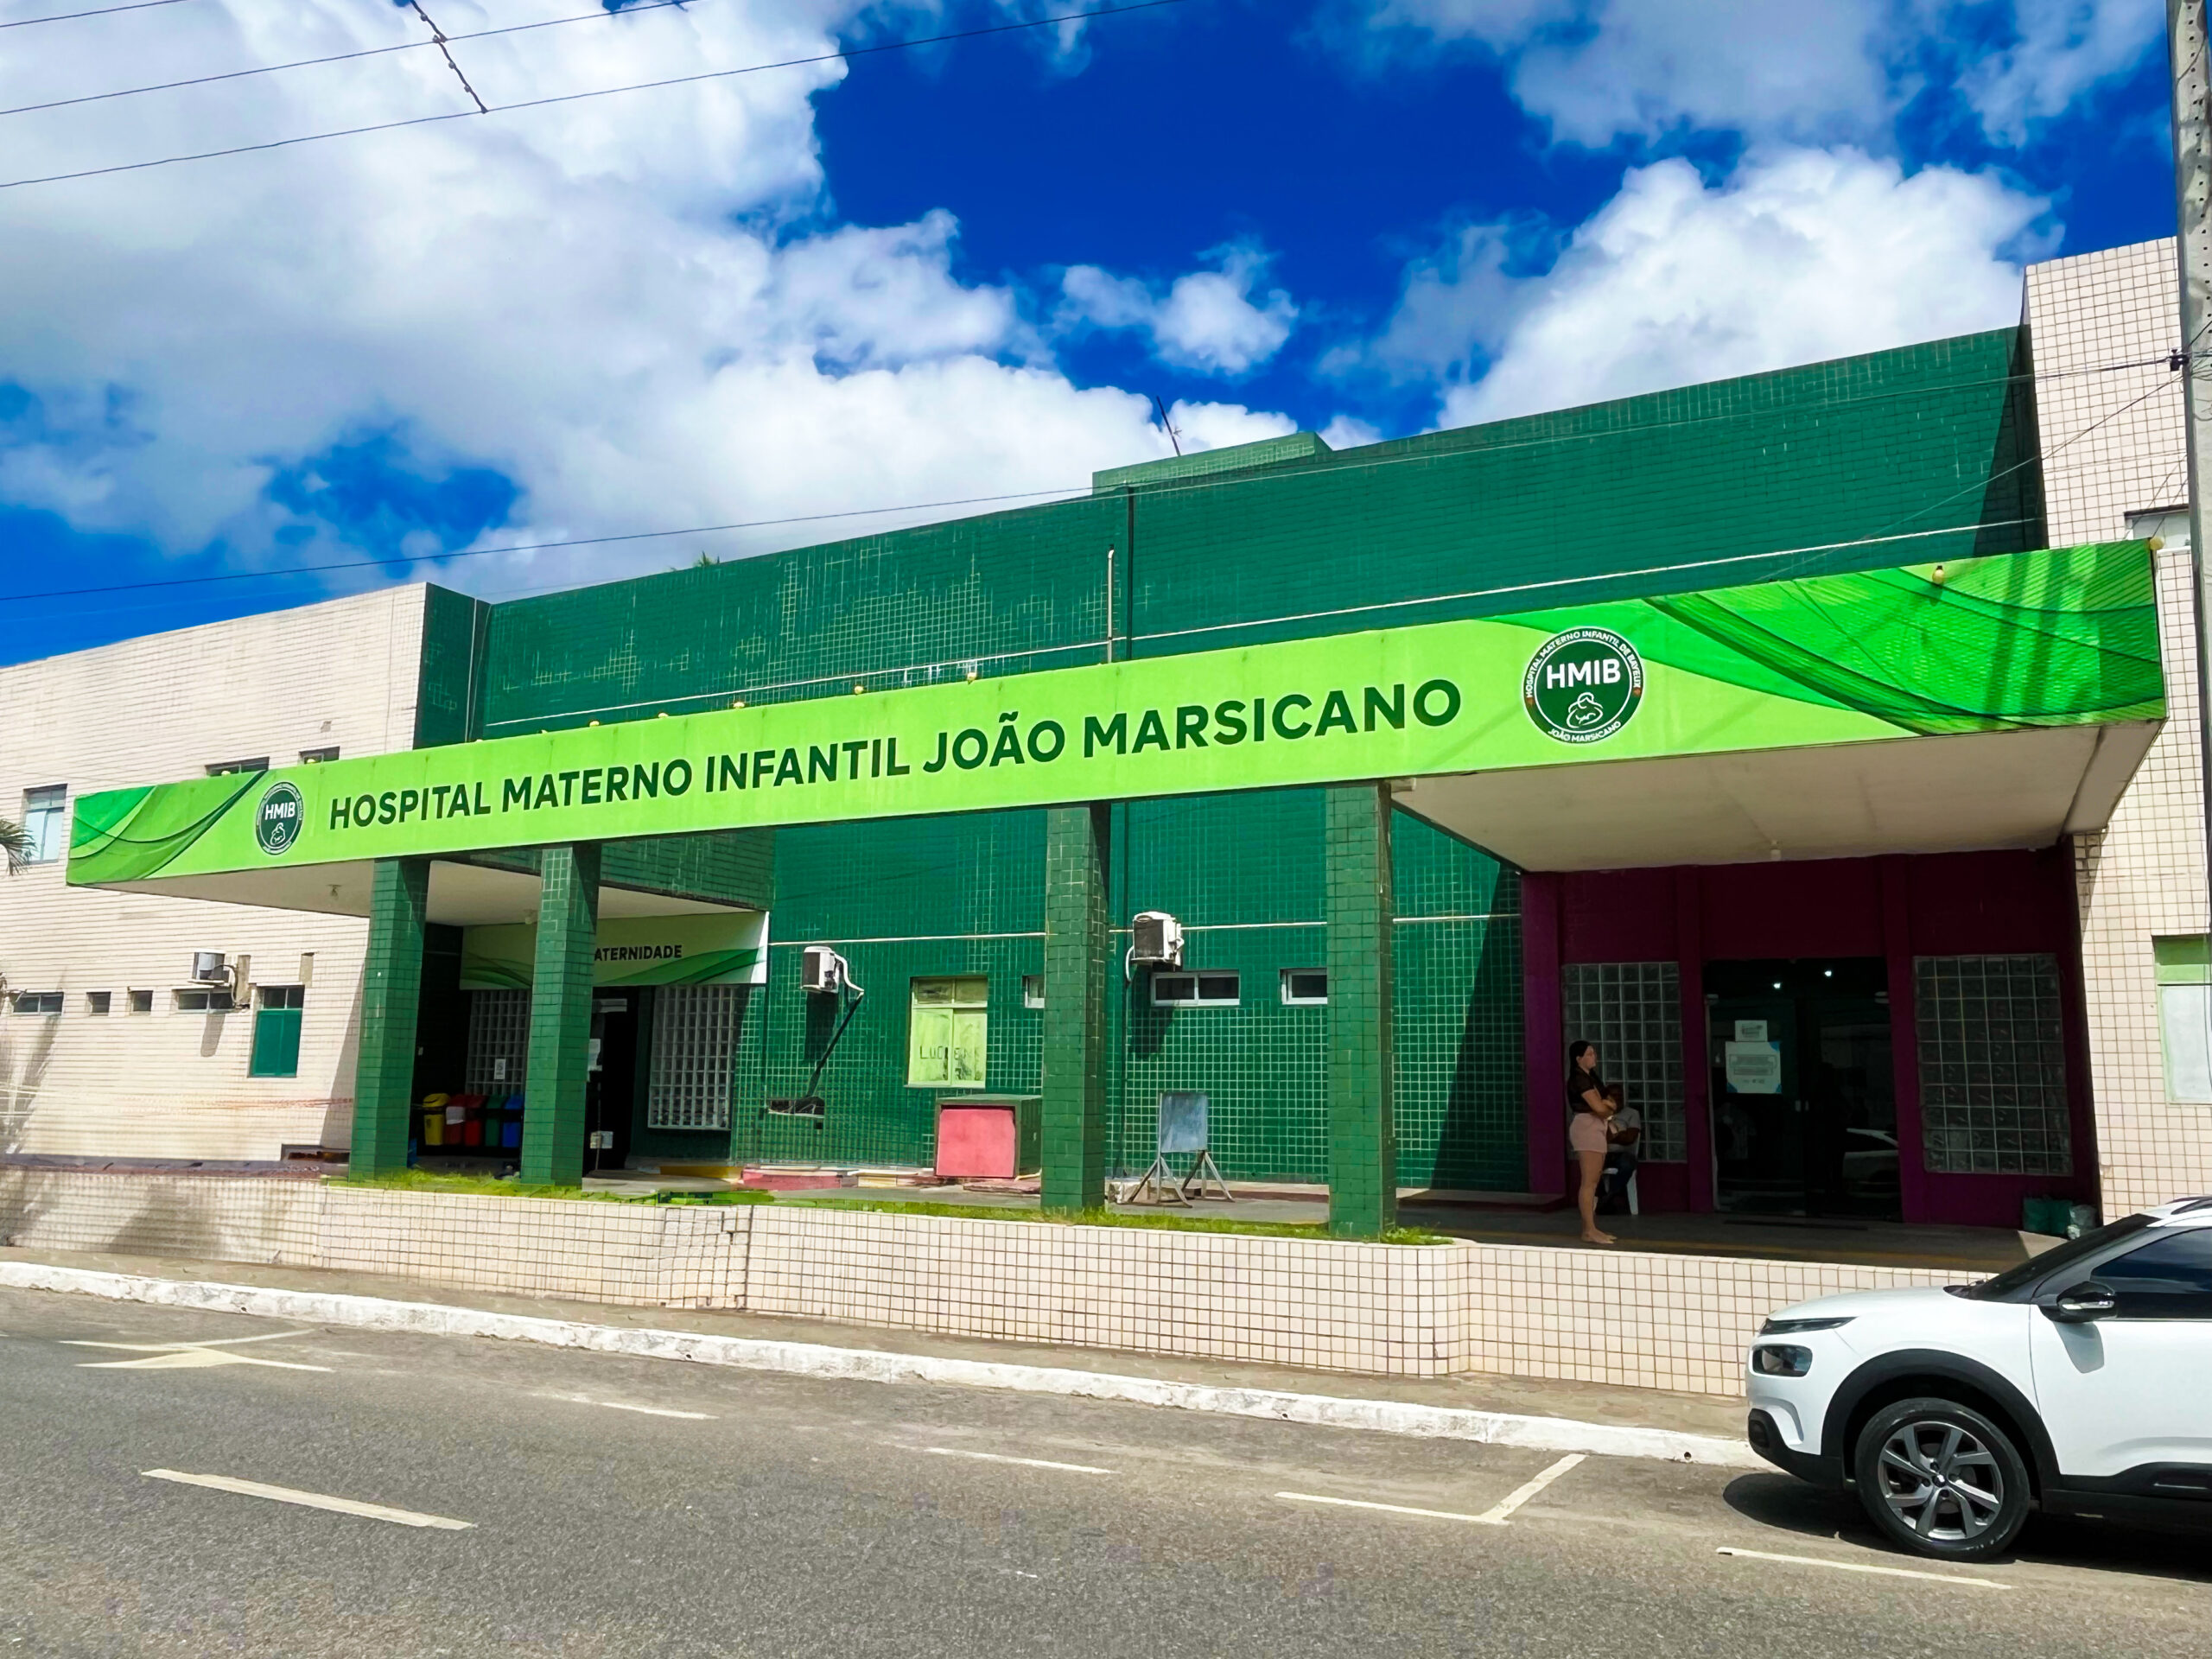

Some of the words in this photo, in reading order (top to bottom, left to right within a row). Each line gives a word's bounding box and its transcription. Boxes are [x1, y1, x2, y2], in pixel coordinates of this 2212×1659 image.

[1525, 657, 1543, 698] HOSPITAL
[1540, 631, 1580, 658] MATERNO
[1581, 630, 1620, 648] INFANTIL
[1547, 658, 1621, 690] HMIB
[1571, 721, 1621, 742] MARSICANO
[330, 781, 491, 830] HOSPITAL
[502, 759, 692, 812] MATERNO
[706, 738, 910, 793] INFANTIL
[923, 712, 1065, 773] JOÃO
[1084, 679, 1461, 758] MARSICANO
[264, 801, 296, 821] HMIB
[594, 944, 683, 962] ATERNIDADE
